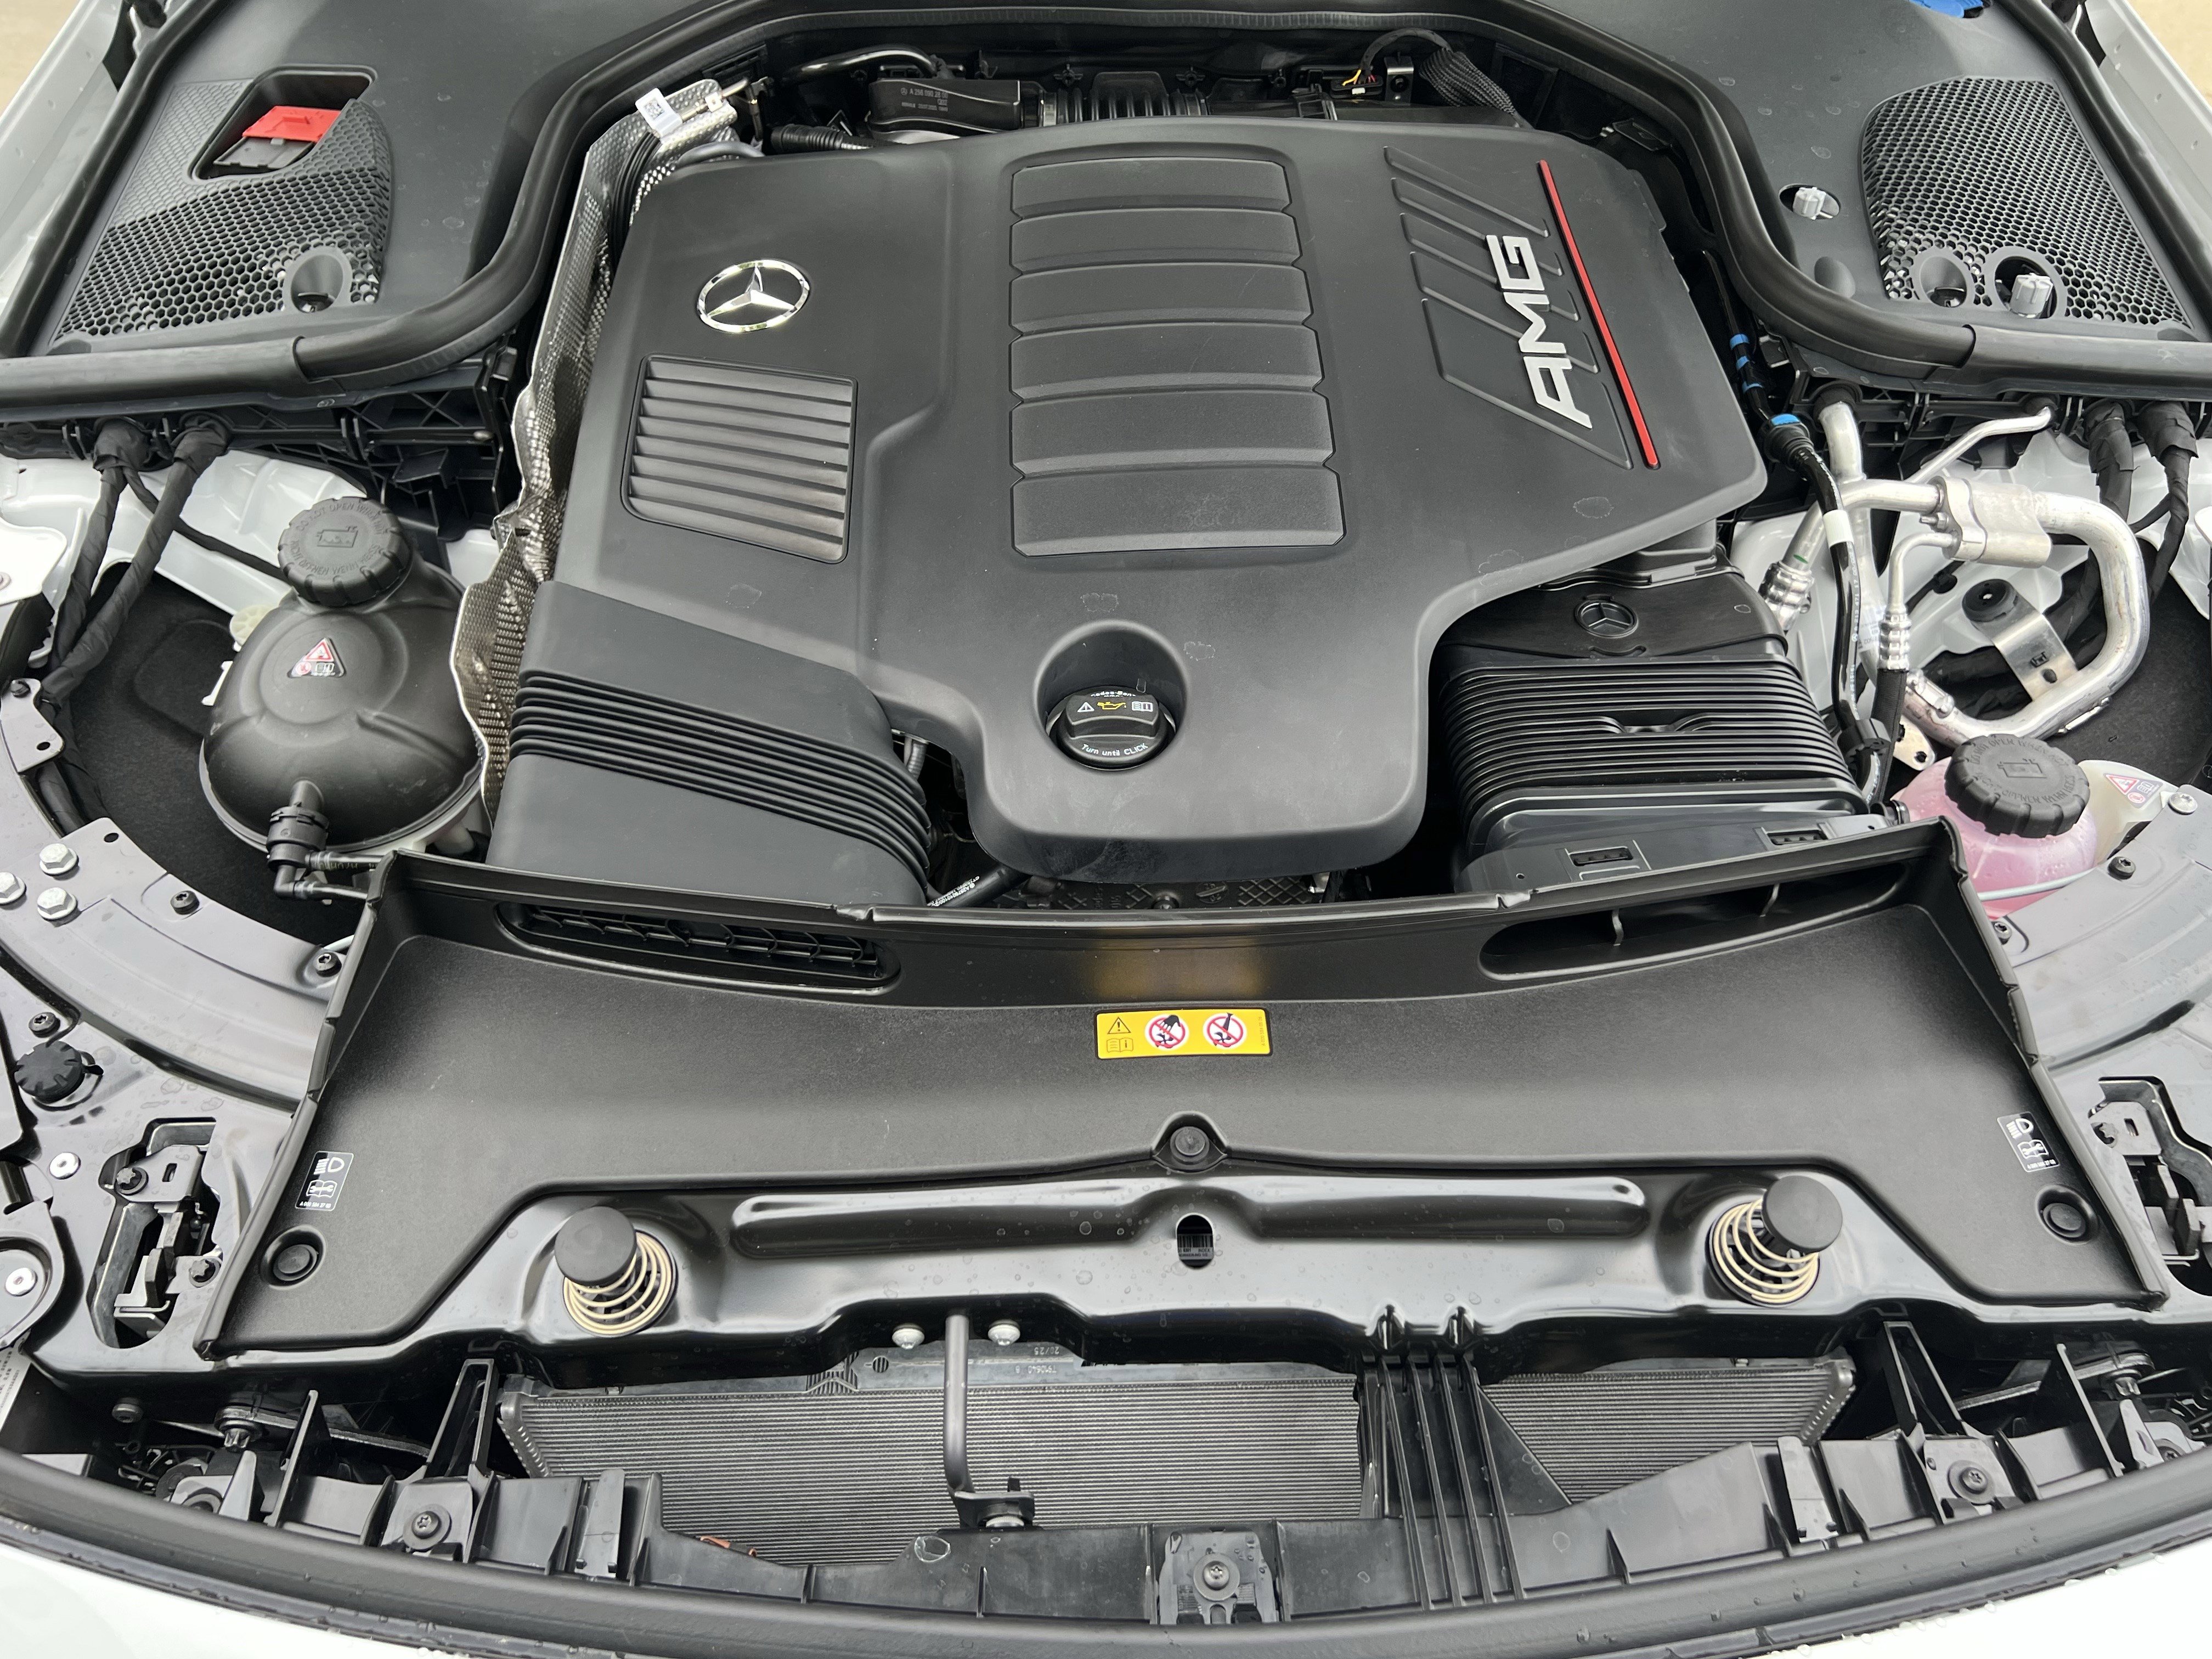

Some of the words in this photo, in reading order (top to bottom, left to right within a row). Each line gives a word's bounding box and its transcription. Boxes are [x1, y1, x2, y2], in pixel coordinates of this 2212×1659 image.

[1486, 235, 1593, 429] AMG
[330, 503, 354, 512] OPEN
[1081, 743, 1099, 755] Turn
[1124, 742, 1148, 755] CLICK
[1034, 1346, 1059, 1355] 20/25
